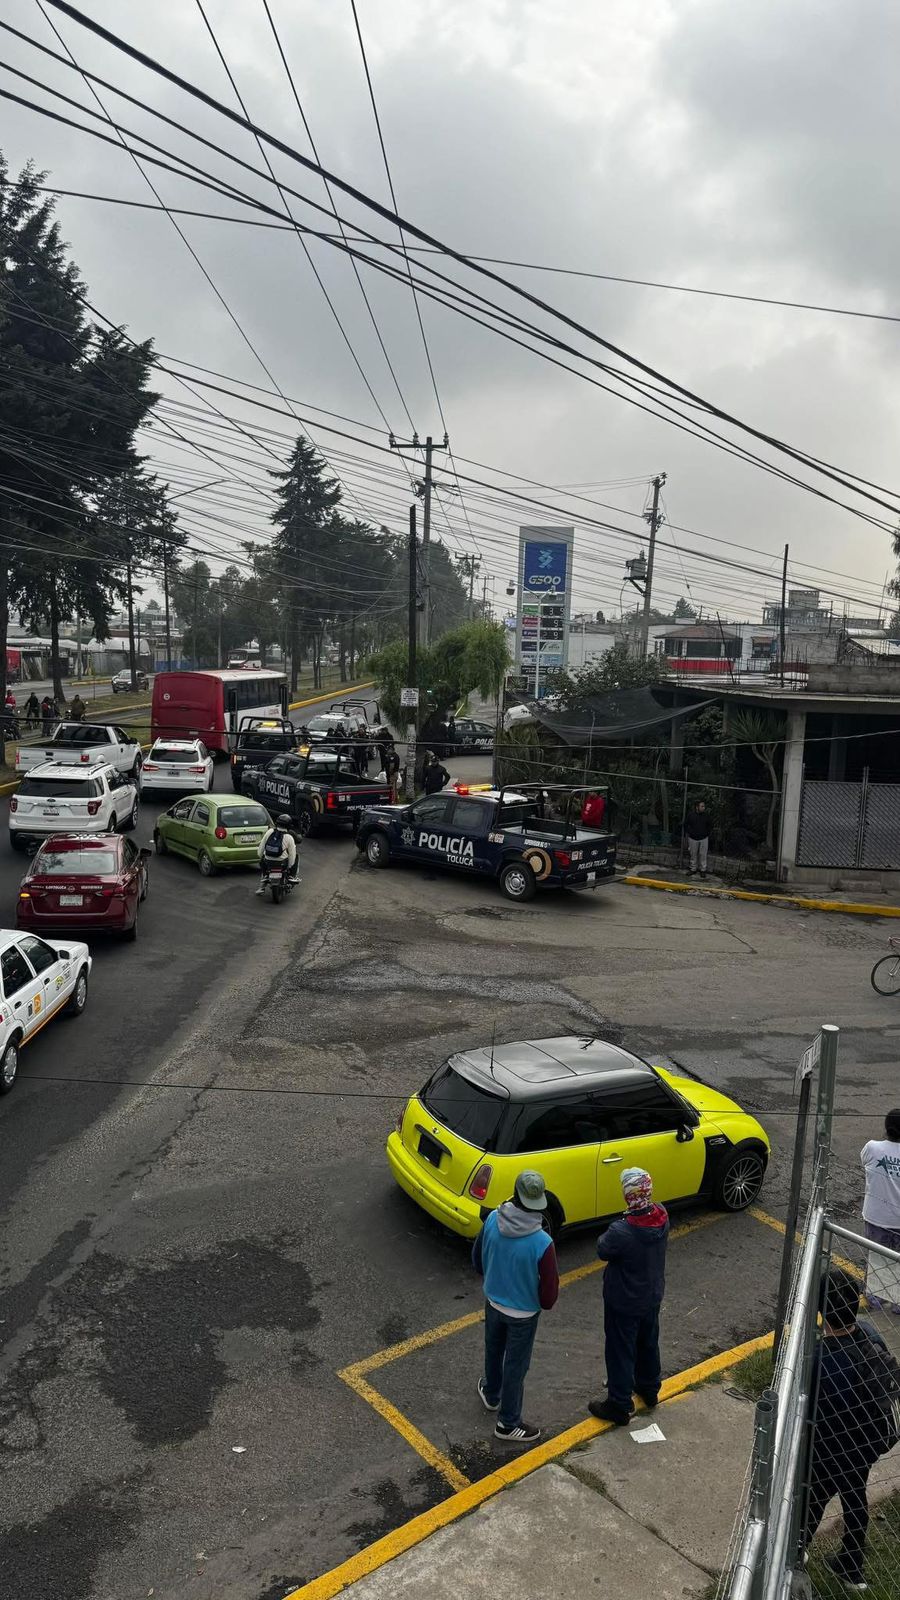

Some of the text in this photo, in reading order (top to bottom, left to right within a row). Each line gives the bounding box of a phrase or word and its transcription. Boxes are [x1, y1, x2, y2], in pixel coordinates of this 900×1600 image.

[266, 780, 290, 798] POLICÍA
[419, 832, 474, 857] POLICÍA
[447, 854, 474, 867] TOLUCA
